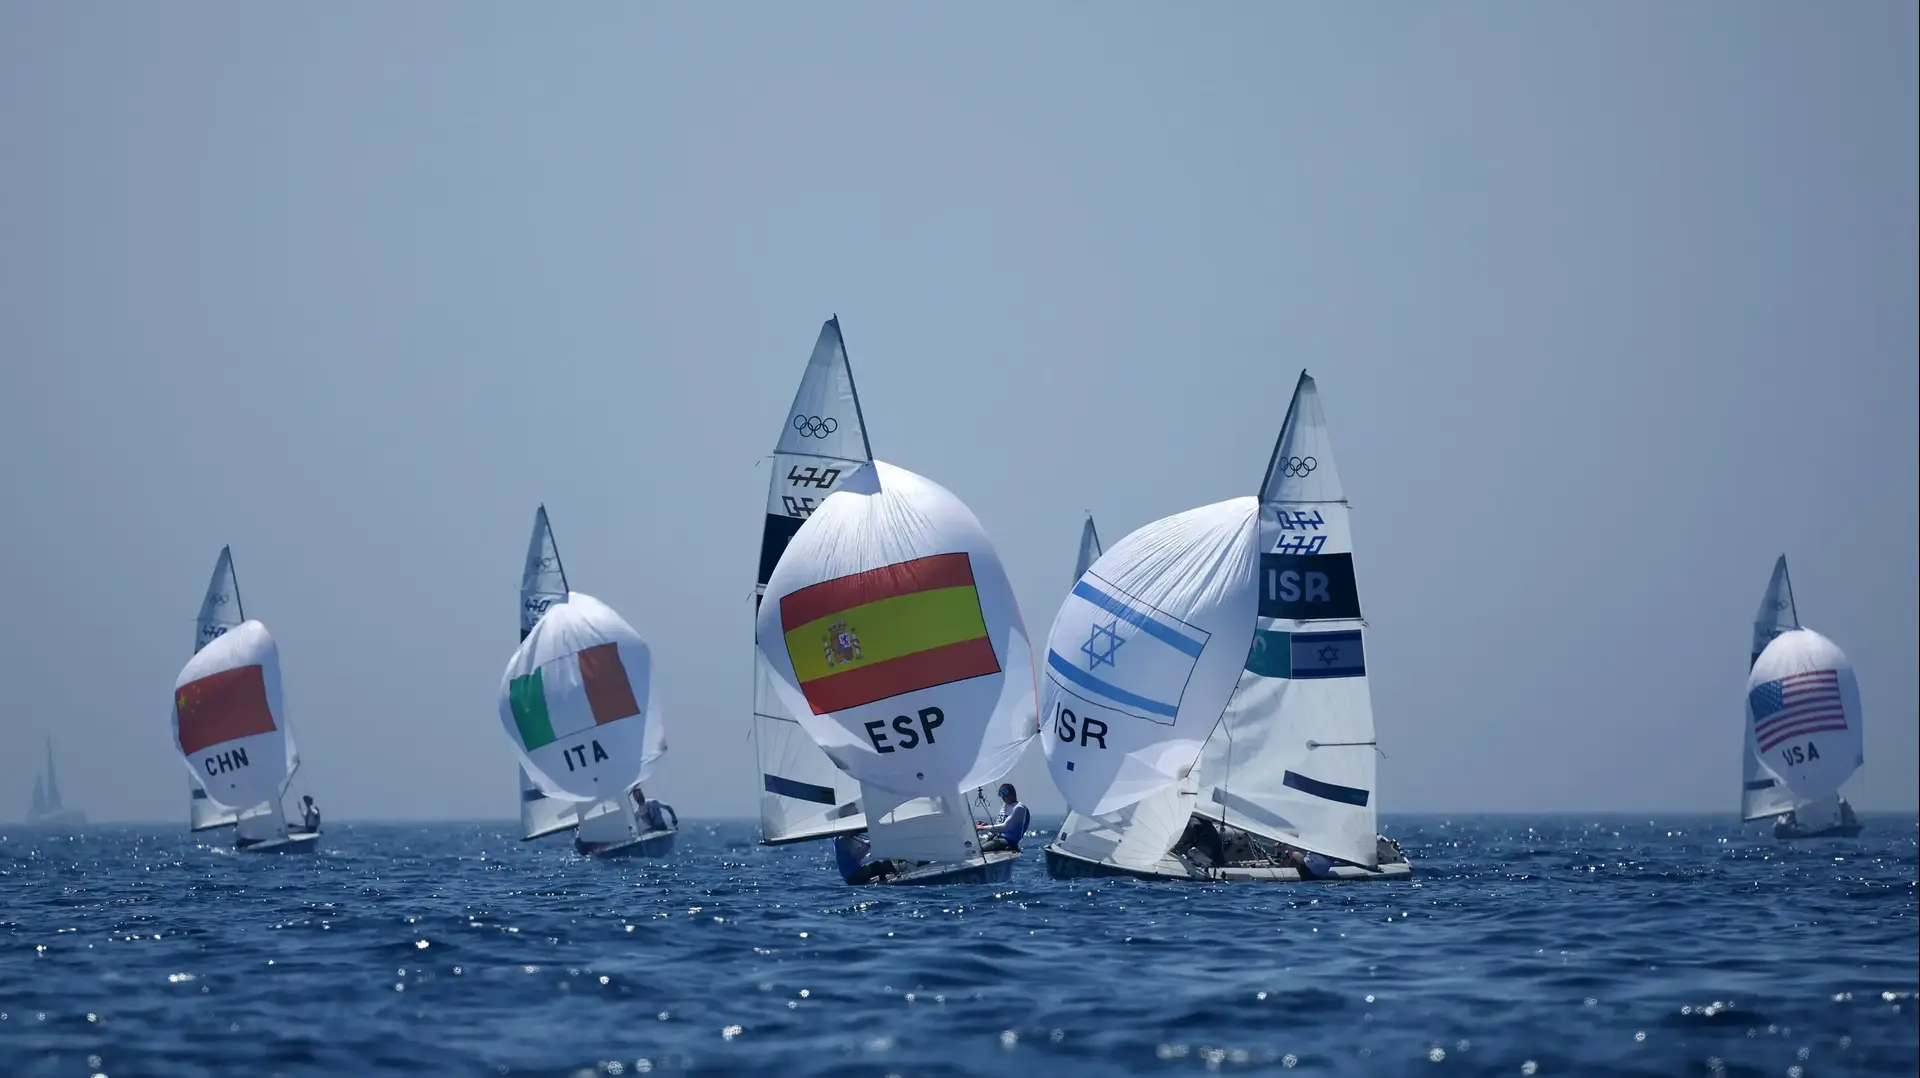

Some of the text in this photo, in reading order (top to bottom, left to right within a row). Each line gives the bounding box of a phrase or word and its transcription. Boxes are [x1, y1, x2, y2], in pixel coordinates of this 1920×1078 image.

[787, 465, 841, 489] 470
[1276, 534, 1327, 555] 470
[1268, 569, 1331, 602] ISR
[864, 706, 945, 753] ESP
[1054, 702, 1108, 749] ISR
[205, 747, 249, 777] CHN
[563, 740, 609, 772] ITA
[1783, 741, 1820, 767] USA
